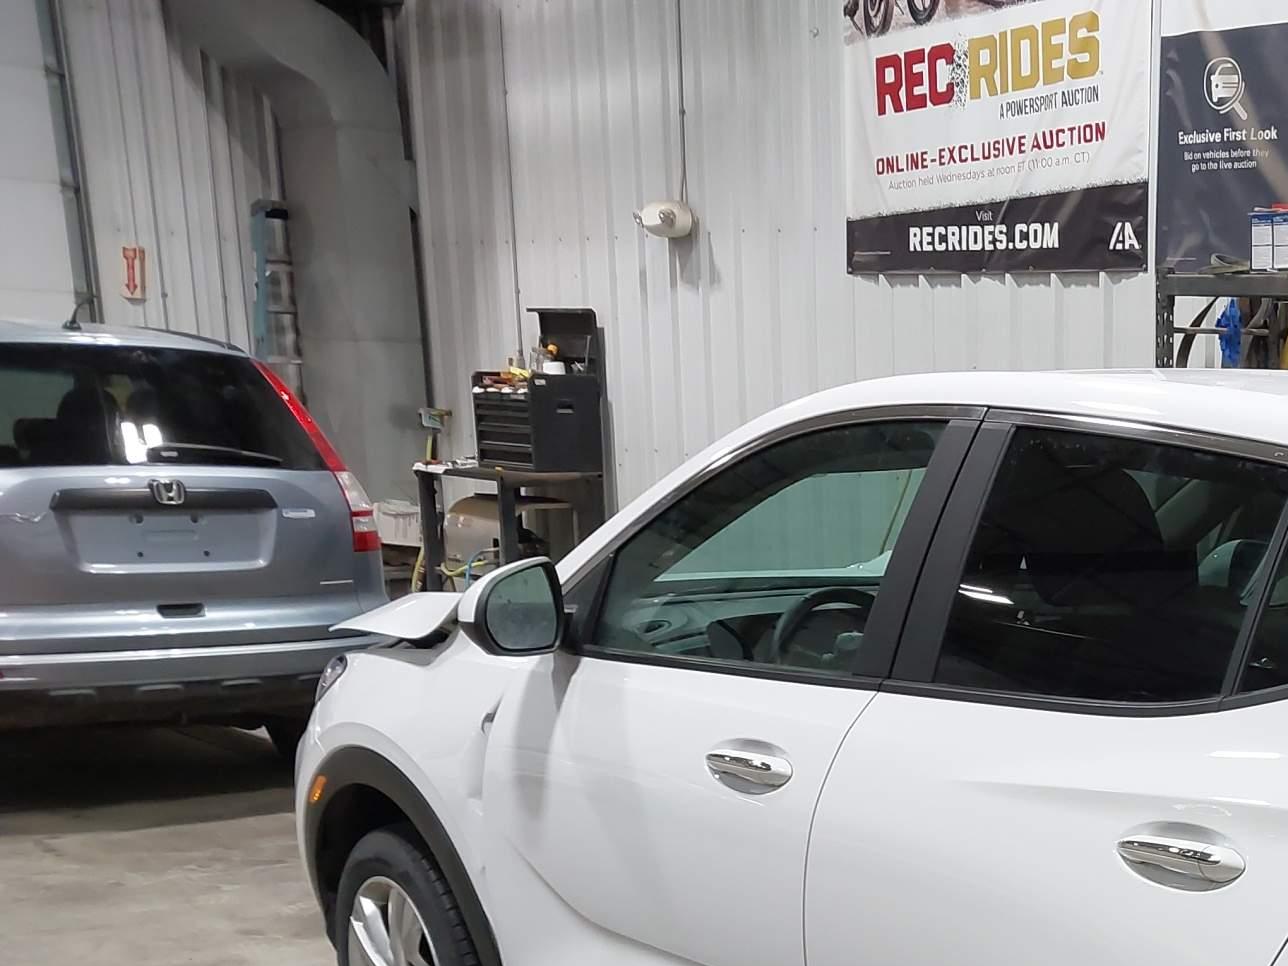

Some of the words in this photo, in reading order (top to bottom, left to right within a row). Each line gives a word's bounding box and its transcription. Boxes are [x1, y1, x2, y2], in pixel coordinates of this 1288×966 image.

[875, 43, 956, 116] REC
[967, 11, 1100, 100] RIDES
[1000, 103, 1005, 120] A
[1006, 92, 1058, 118] POWERSPORT
[1061, 85, 1099, 108] AUCTION
[876, 135, 1026, 175] ONLINE-EXCLUSIVE
[1030, 121, 1107, 151] AUCTION
[1178, 130, 1221, 144] Exclusive
[1223, 127, 1247, 141] First
[1250, 126, 1278, 140] Look
[1184, 151, 1193, 160] Bid
[1202, 149, 1230, 159] vehicles
[1230, 148, 1251, 158] before
[1252, 148, 1270, 158] they
[1191, 163, 1200, 173] go
[1200, 161, 1207, 171] to
[1207, 161, 1218, 170] the
[1219, 159, 1233, 169] live
[1233, 159, 1257, 169] auction
[888, 178, 917, 191] Auction
[918, 174, 934, 187] held
[935, 169, 985, 184] Wednesdays
[987, 167, 995, 178] at
[1073, 150, 1090, 166] CT)
[975, 209, 993, 222] Visit
[909, 222, 1060, 252] RECRIDES.COM
